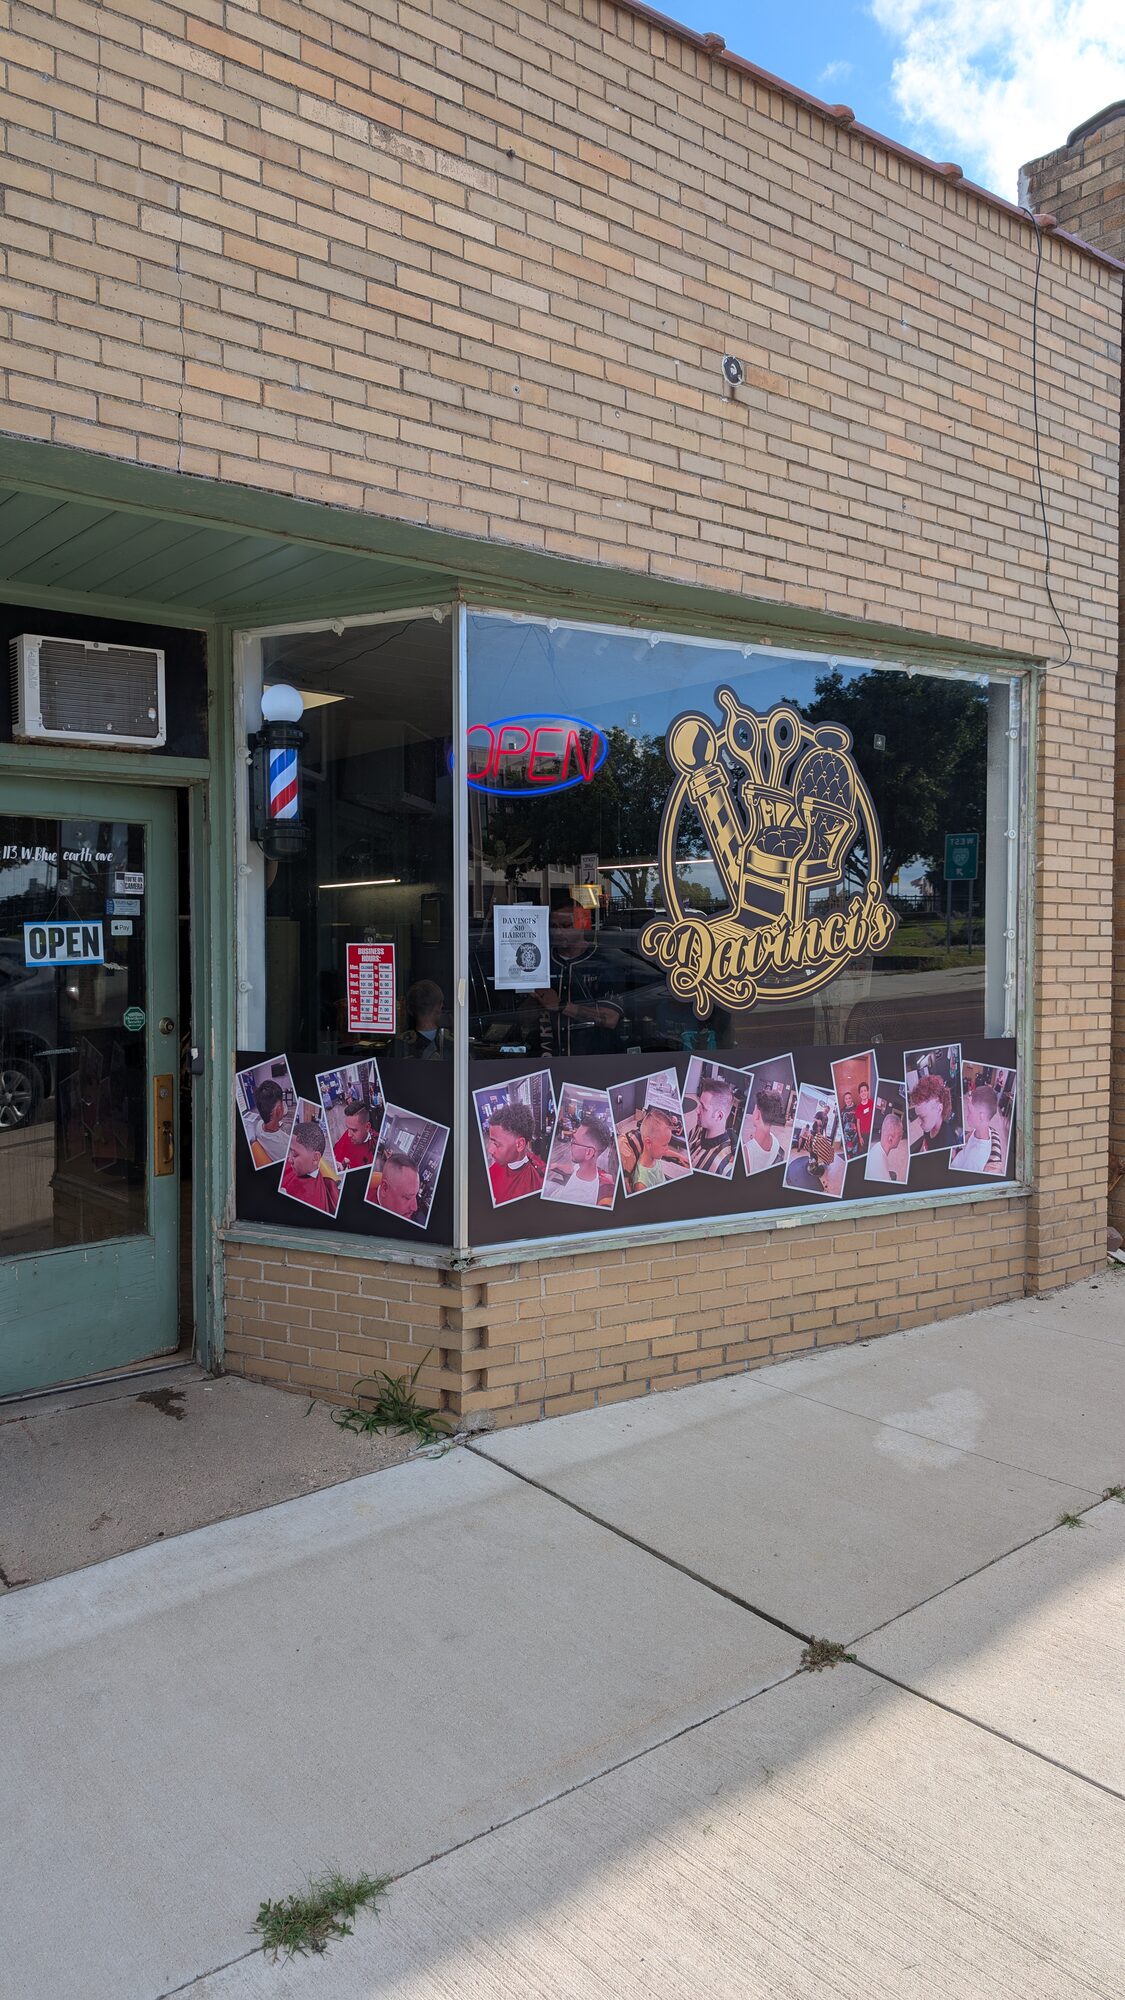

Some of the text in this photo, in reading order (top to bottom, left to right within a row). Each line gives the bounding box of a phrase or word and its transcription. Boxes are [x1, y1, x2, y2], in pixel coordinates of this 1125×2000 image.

[467, 724, 599, 782] OPEN
[3, 845, 18, 860] 113
[63, 847, 92, 862] earth
[95, 851, 114, 862] ave
[125, 882, 143, 890] CAMERA
[120, 924, 130, 932] Pay
[502, 931, 537, 939] HAIRCUTS
[28, 926, 100, 960] OPEN
[641, 879, 896, 1016] Davinci's
